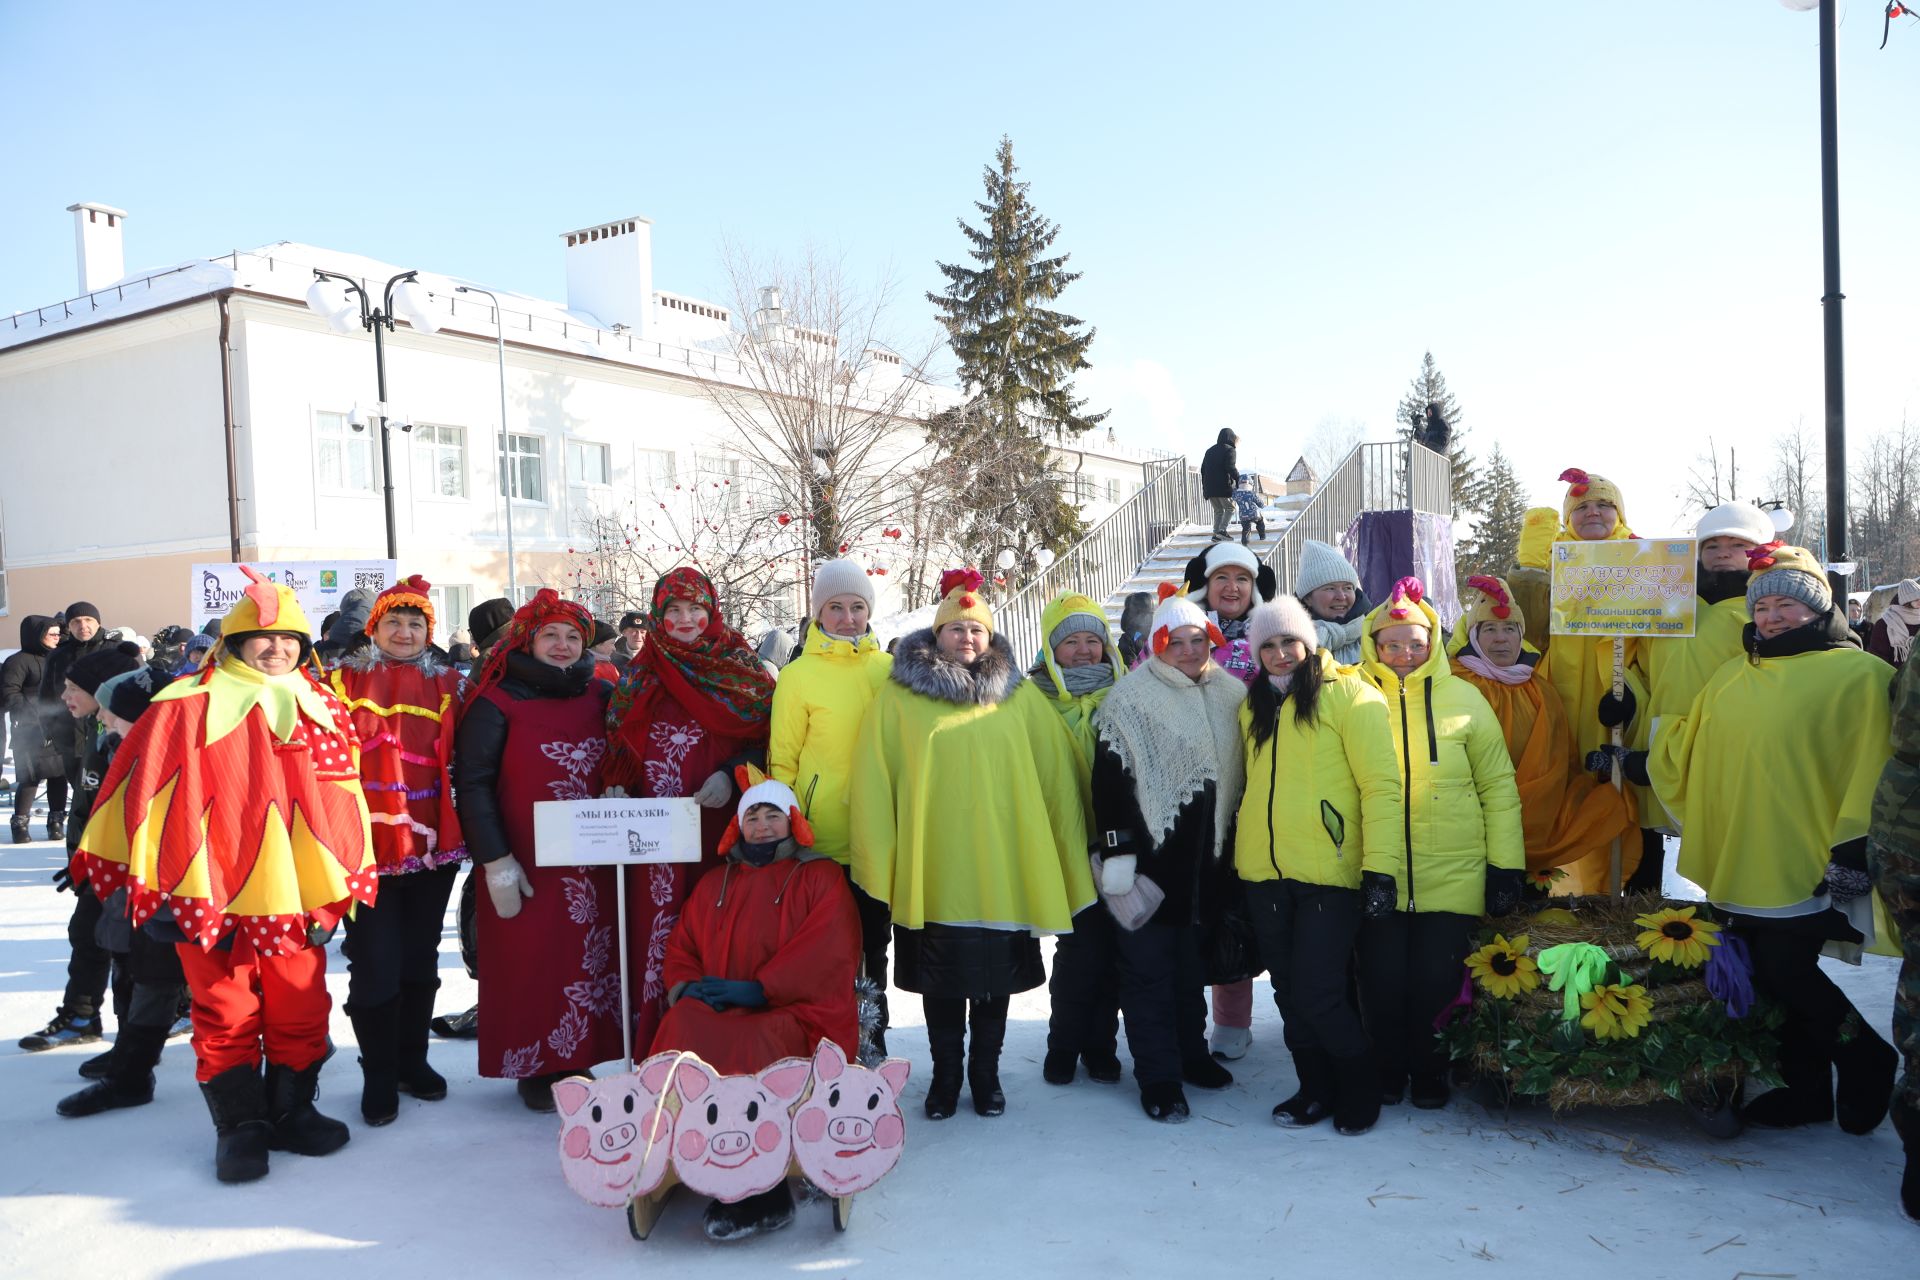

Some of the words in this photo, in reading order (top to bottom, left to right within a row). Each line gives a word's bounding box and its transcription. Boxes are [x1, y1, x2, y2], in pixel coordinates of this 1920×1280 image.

[286, 579, 308, 587] SUNNY
[1586, 607, 1662, 616] Таканышская
[1656, 621, 1683, 630] зона
[576, 810, 601, 819] «МЫ
[604, 810, 618, 818] ИЗ
[620, 809, 669, 818] СКАЗКИ»
[629, 840, 660, 848] SUNNY
